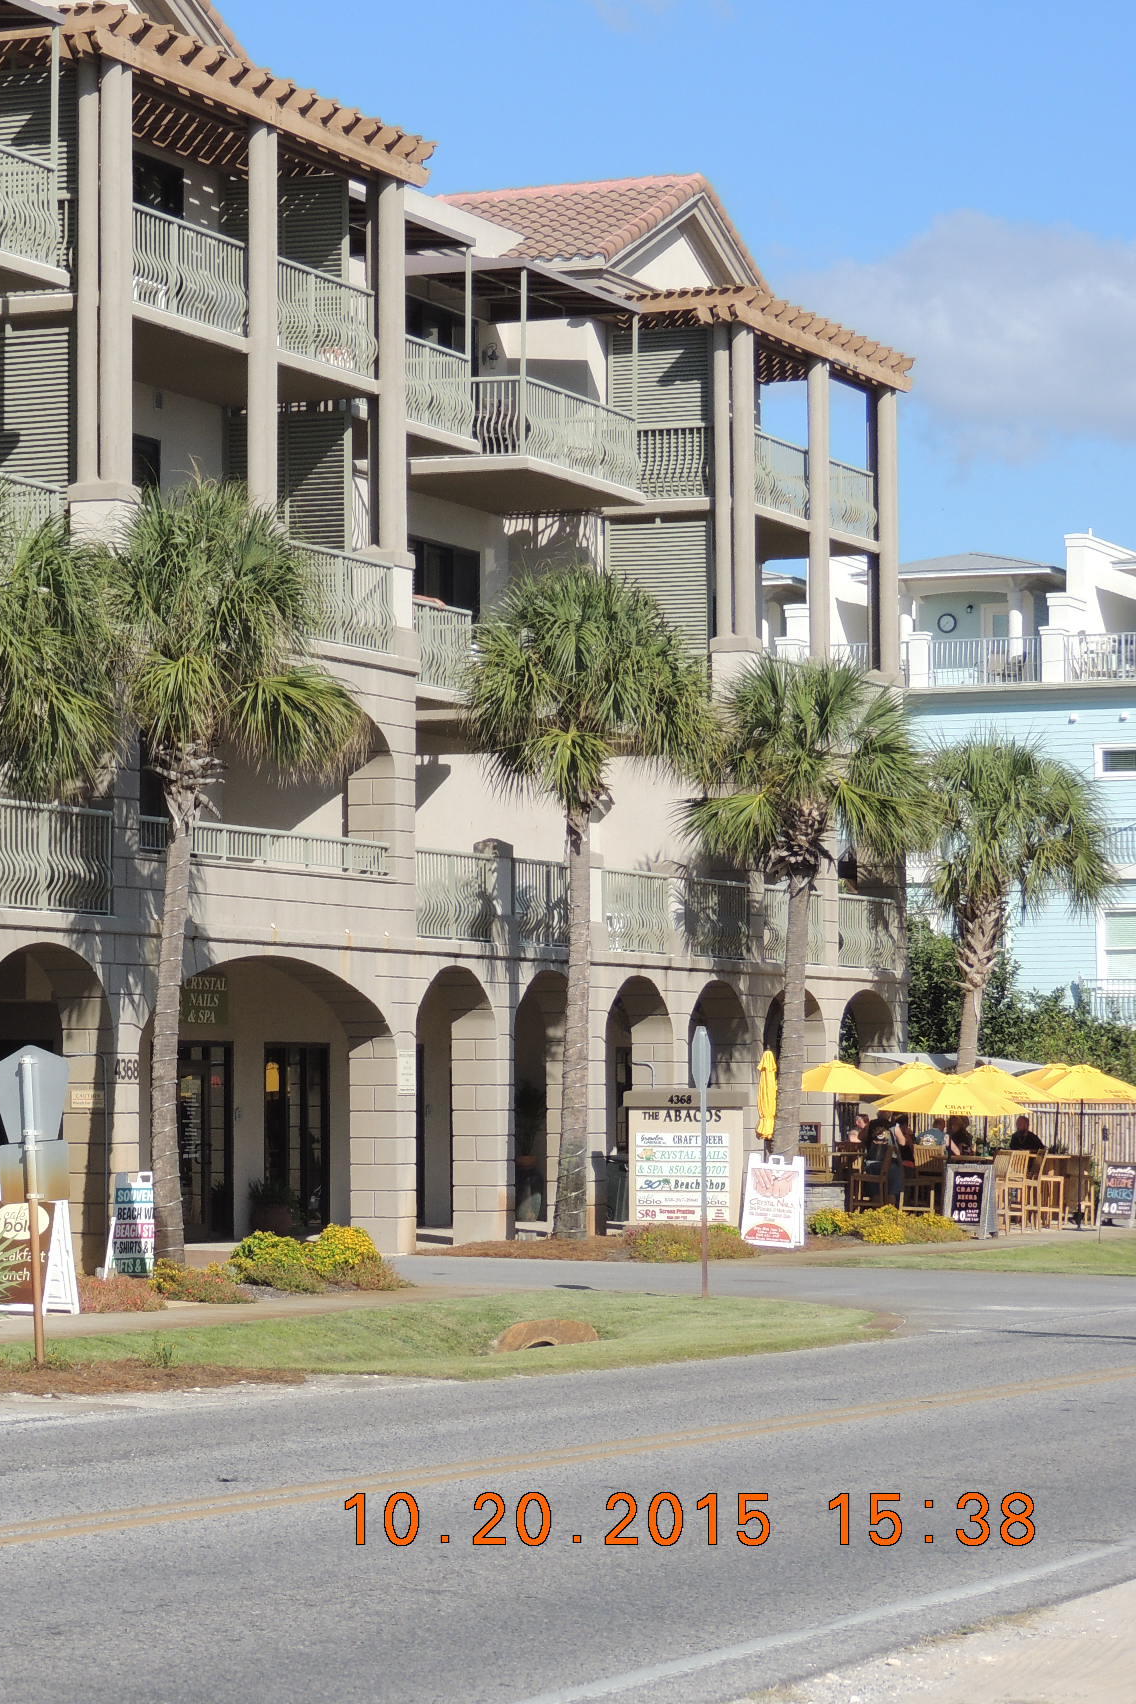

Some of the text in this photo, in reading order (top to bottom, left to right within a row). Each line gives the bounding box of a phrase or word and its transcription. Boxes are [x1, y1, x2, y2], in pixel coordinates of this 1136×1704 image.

[184, 976, 227, 991] CRYSTAL
[190, 993, 220, 1007] NAILS
[188, 1010, 216, 1024] & SPA
[115, 1058, 140, 1080] 4368
[668, 1095, 692, 1105] 4368
[642, 1109, 722, 1123] THE ABACOS
[672, 1134, 700, 1145] CRAFT
[653, 1150, 697, 1160] CRYSTAL
[637, 1165, 644, 1174] &
[647, 1165, 664, 1174] SPA
[673, 1179, 700, 1190] Beach
[117, 1207, 142, 1220] BEACH
[1102, 1202, 1117, 1214] 40
[952, 1209, 966, 1222] 40
[4, 1218, 31, 1233] bol
[115, 1224, 141, 1238] BEACH
[113, 1241, 142, 1255] T-SHIRTS
